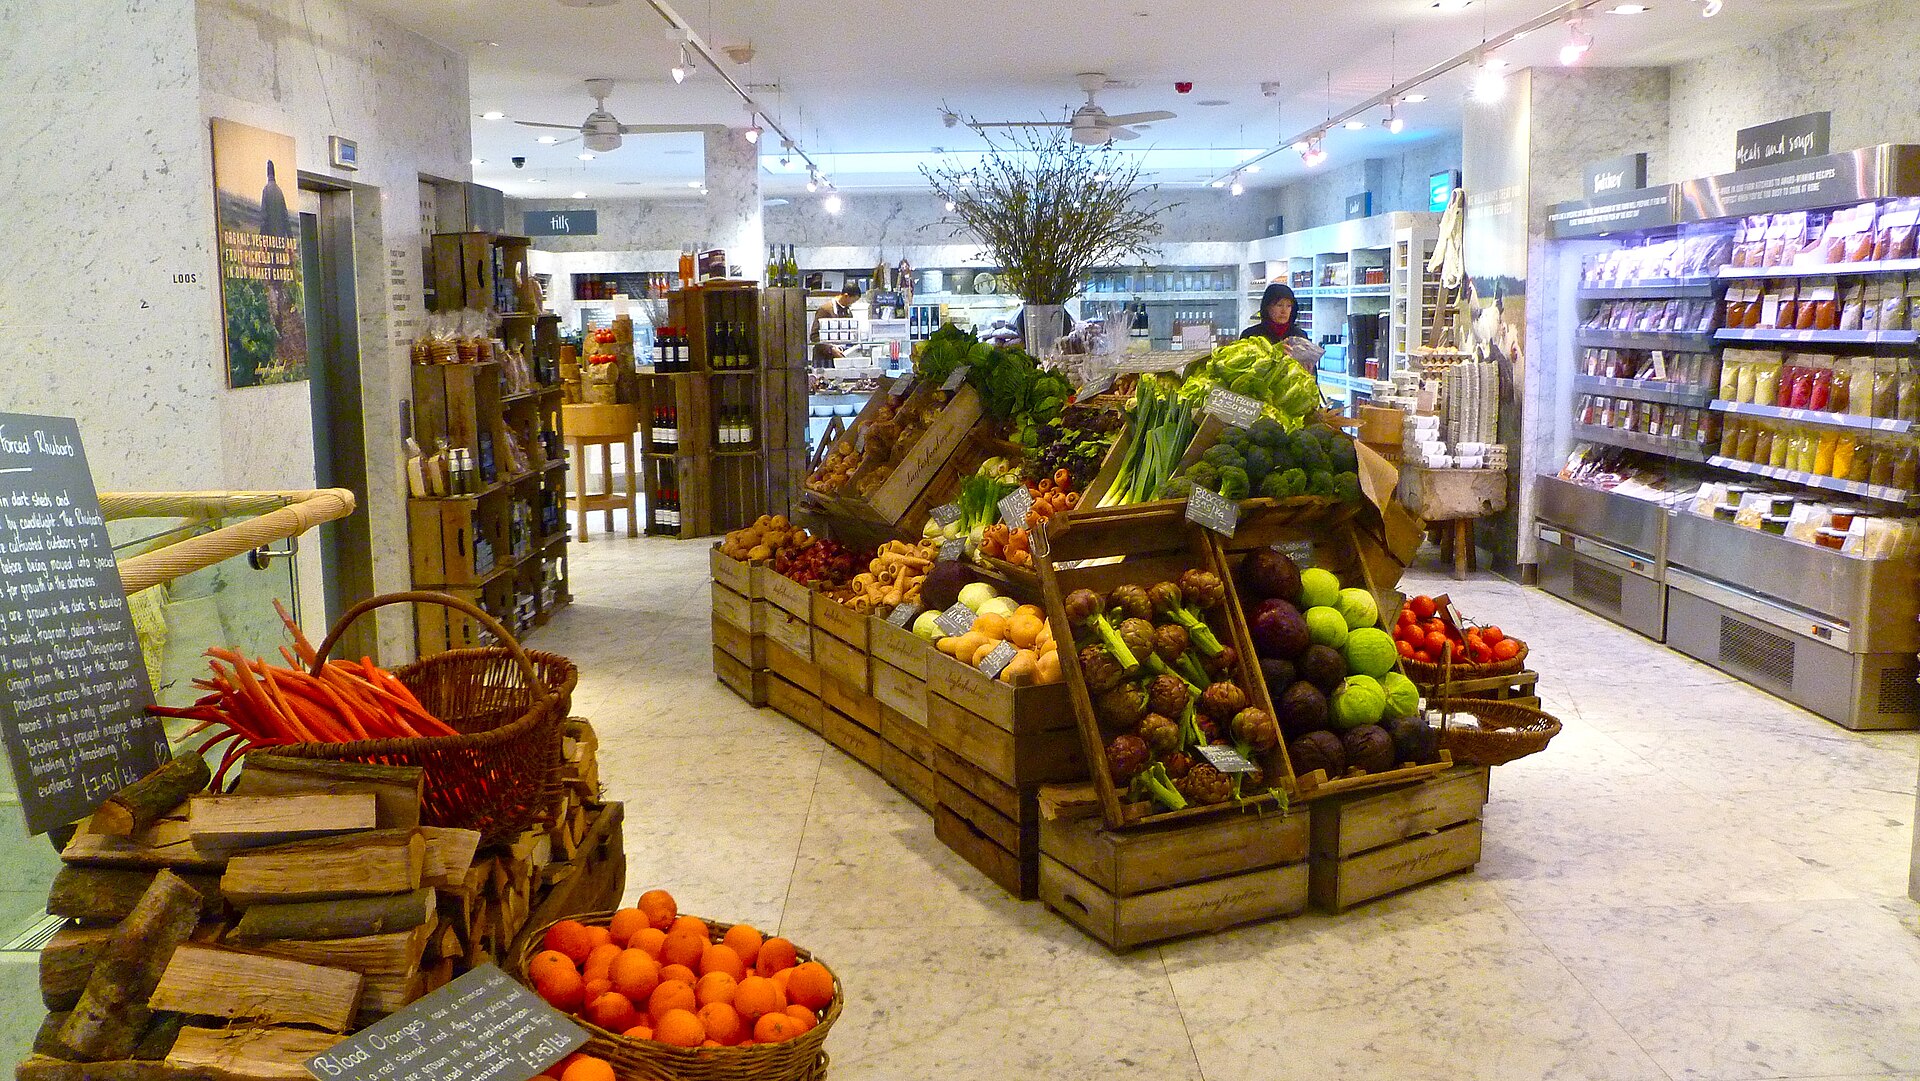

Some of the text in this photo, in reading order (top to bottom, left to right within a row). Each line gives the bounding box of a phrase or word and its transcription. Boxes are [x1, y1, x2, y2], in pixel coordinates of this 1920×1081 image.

[1764, 134, 1785, 158] and
[1789, 131, 1814, 155] soups
[549, 214, 570, 233] tills
[224, 231, 250, 246] ORGANIC
[251, 233, 285, 249] VEGETABLES
[225, 248, 243, 263] FRUIT
[244, 249, 265, 264] PICKED
[275, 252, 290, 265] HAND
[172, 273, 197, 284] LOOS
[226, 265, 294, 281] IN OUR MARKET GARDEN
[33, 430, 74, 457] Rhubarb
[11, 490, 30, 507] dark
[31, 491, 53, 507] sheds
[55, 489, 70, 506] and
[5, 514, 20, 541] by
[59, 509, 75, 527] The
[74, 507, 103, 526] Rhubarb
[8, 534, 43, 553] cultivated
[46, 534, 76, 551] outdoors
[77, 534, 89, 552] for
[90, 532, 98, 548] 2
[1, 553, 115, 579] before being moved into special
[6, 580, 18, 601] for
[20, 577, 46, 602] growth
[47, 579, 54, 592] in
[55, 575, 67, 590] the
[8, 610, 23, 622] are
[26, 608, 50, 627] grown
[59, 601, 71, 614] the
[70, 597, 86, 613] dark
[88, 595, 97, 611] to
[98, 592, 122, 611] develop
[70, 620, 95, 638] delicate
[12, 658, 29, 670] now
[29, 650, 43, 666] has
[47, 654, 54, 665] a
[53, 644, 87, 662] Protected
[86, 638, 124, 661] Designation
[7, 655, 129, 698] Origin from the EU for the dozen
[13, 694, 51, 718] producers
[54, 689, 80, 704] across
[80, 682, 93, 697] the
[117, 674, 138, 691] which
[45, 712, 52, 729] it
[56, 713, 69, 725] can
[68, 706, 79, 721] be
[80, 704, 97, 724] only
[99, 701, 121, 721] grown
[122, 695, 131, 709] in
[22, 738, 60, 758] Yorkshire
[61, 731, 71, 748] to
[73, 724, 100, 749] prevent
[102, 721, 129, 743] anyone
[130, 715, 143, 729] else
[313, 1044, 372, 1077] Blood
[368, 1019, 426, 1051] Oranges
[429, 1008, 450, 1020] have
[451, 1003, 459, 1011] a
[458, 986, 487, 1006] crimson
[368, 1073, 380, 1081] a
[378, 1059, 397, 1076] red
[395, 1043, 429, 1065] stained
[450, 1019, 476, 1034] they
[470, 1010, 486, 1023] are
[485, 999, 512, 1019] juicy
[506, 987, 523, 1003] and
[420, 1055, 450, 1079] grown
[449, 1048, 462, 1059] in
[459, 1039, 478, 1050] the
[442, 1065, 464, 1081] used
[463, 1060, 475, 1071] in
[501, 1036, 512, 1047] or
